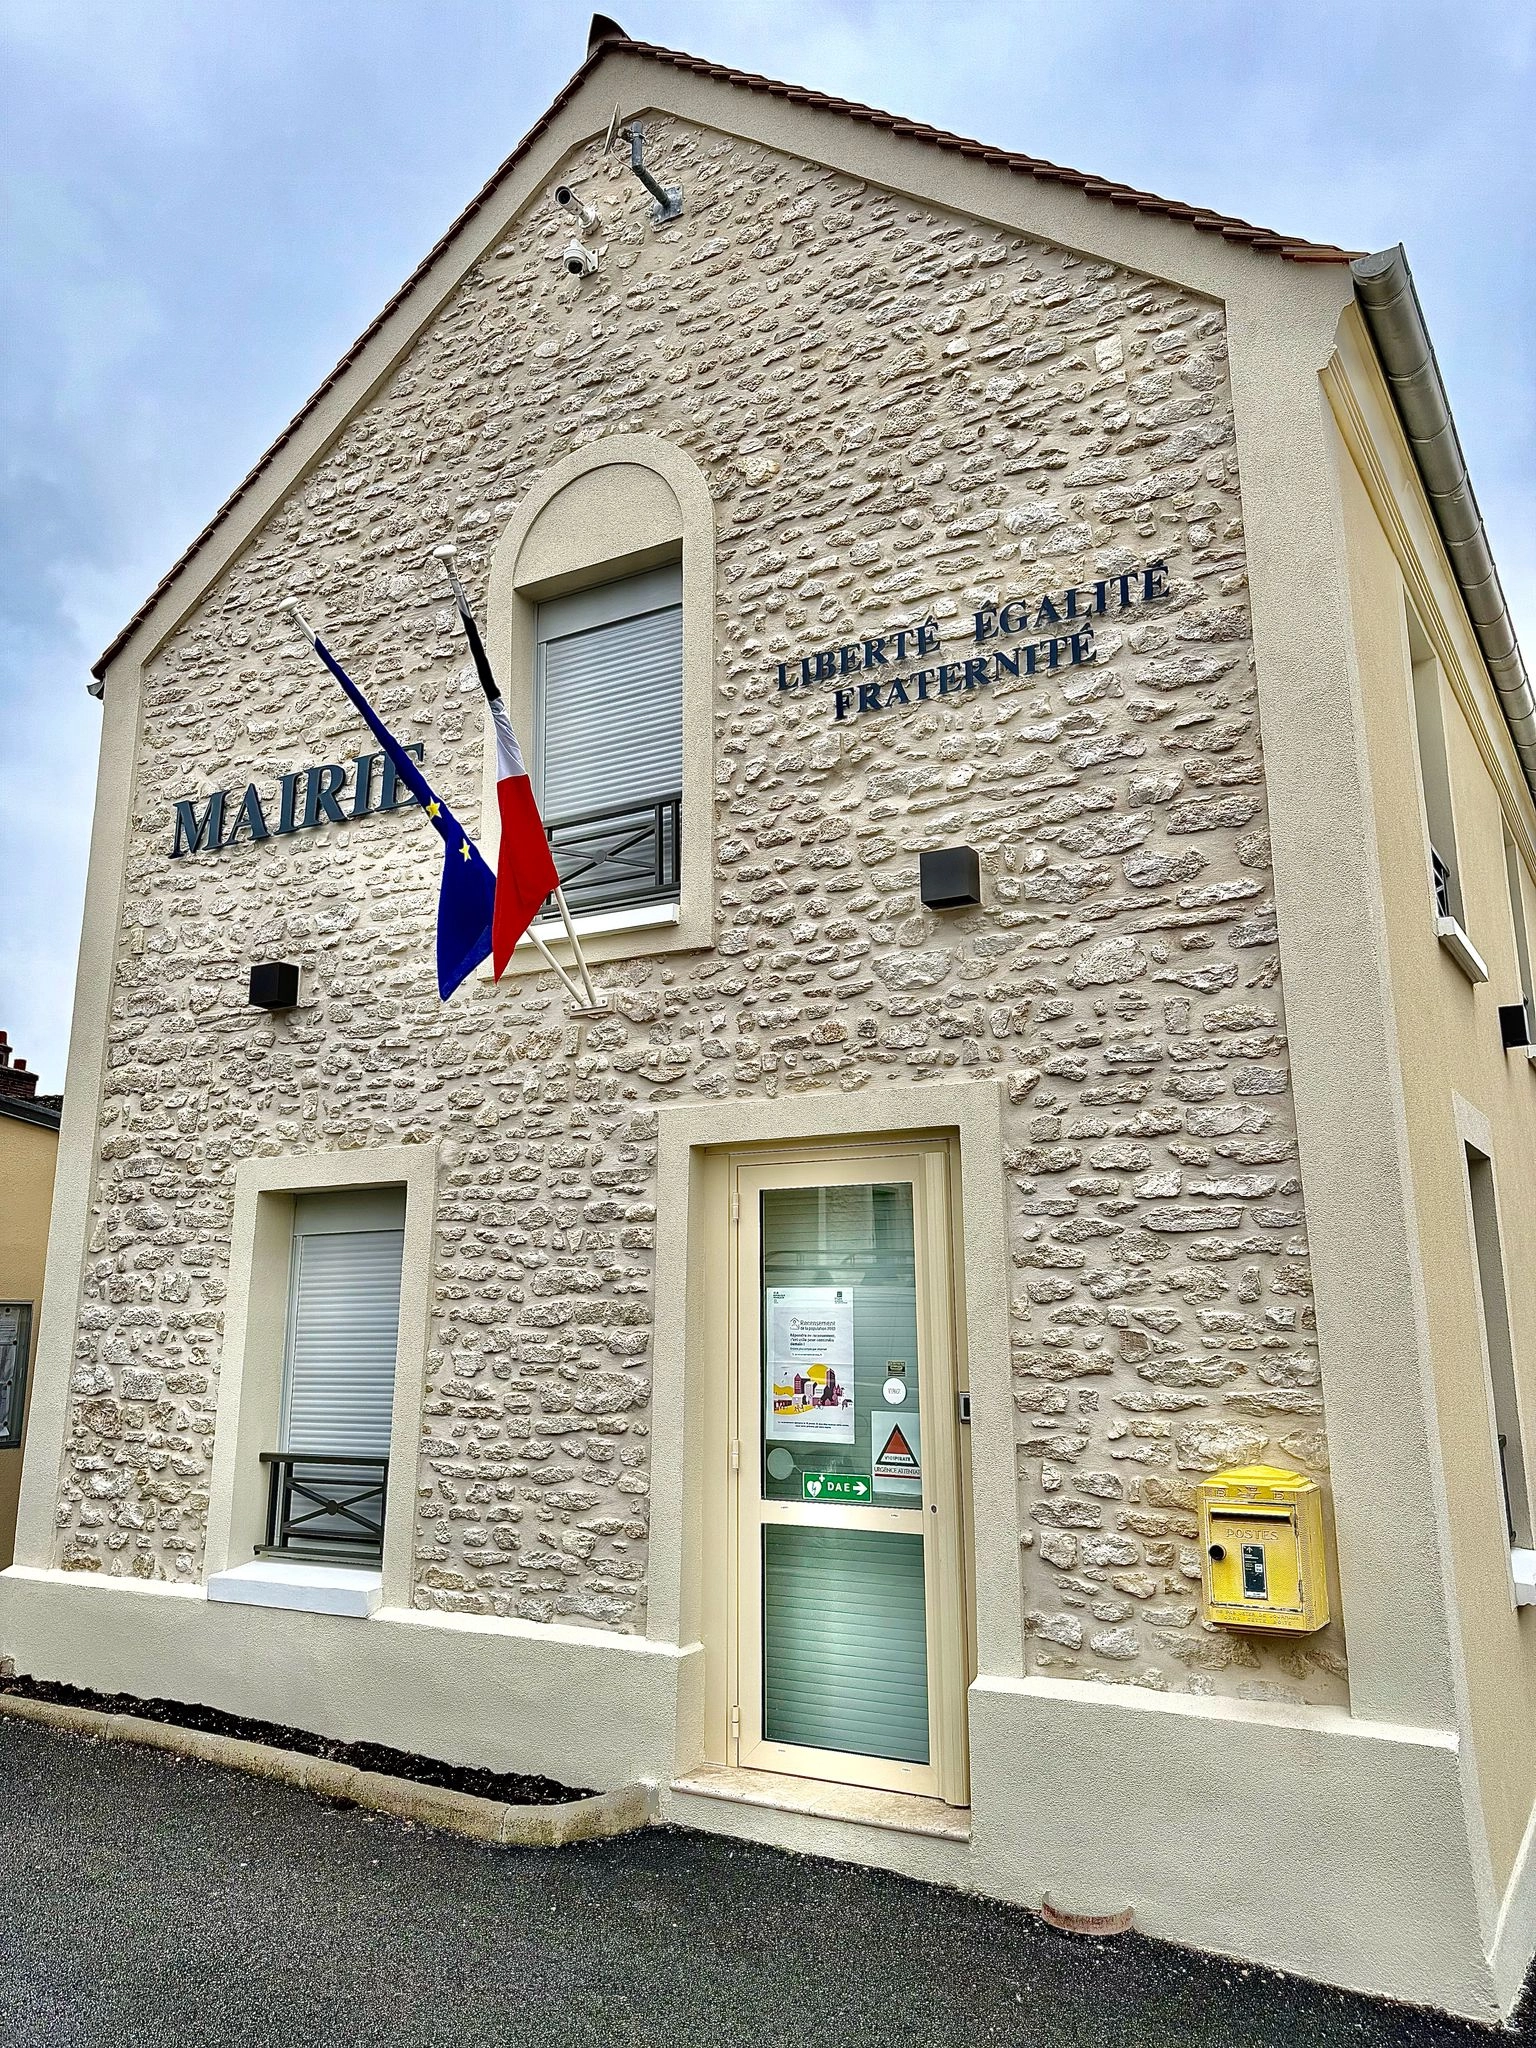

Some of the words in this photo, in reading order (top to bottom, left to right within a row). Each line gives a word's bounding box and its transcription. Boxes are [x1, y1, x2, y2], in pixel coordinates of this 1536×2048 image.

[776, 615, 940, 692] LIBERTÉ
[973, 560, 1170, 644] ÉGALITÉ
[832, 624, 1097, 721] FRATERNITÉ
[168, 742, 425, 859] MAIRIE
[827, 1481, 851, 1492] DAE
[1225, 1528, 1279, 1541] POSTES
